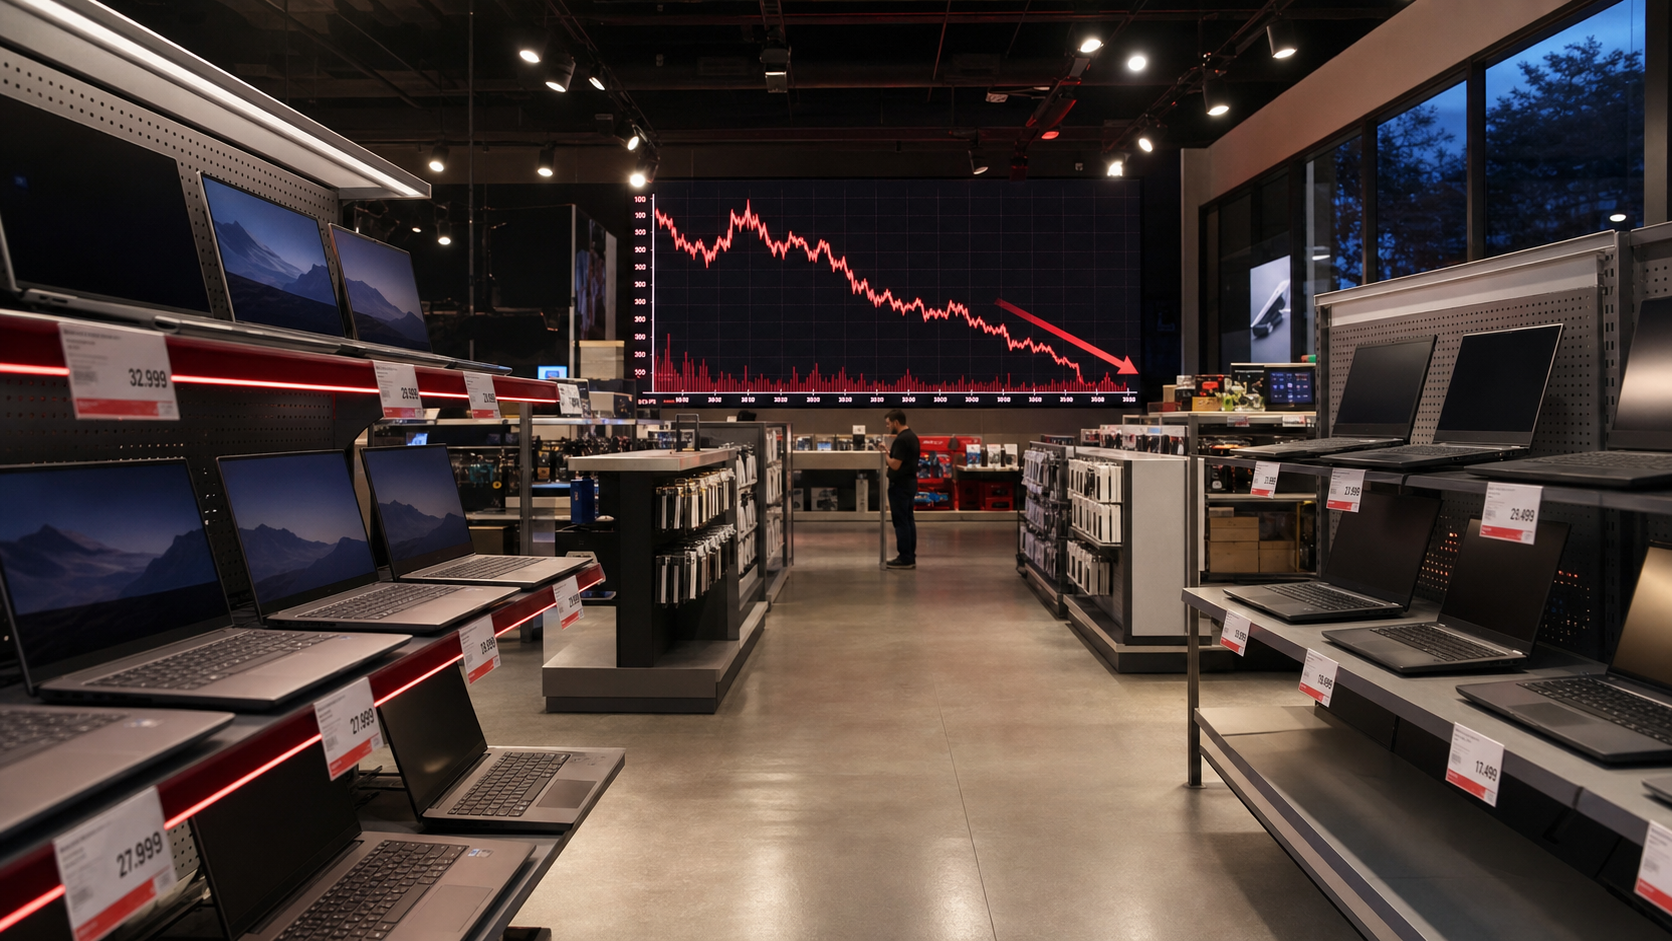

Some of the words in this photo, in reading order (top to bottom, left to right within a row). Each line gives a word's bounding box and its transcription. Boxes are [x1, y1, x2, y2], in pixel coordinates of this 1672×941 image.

[128, 368, 168, 388] 32.999
[350, 708, 375, 735] 27.999
[1475, 760, 1498, 782] 17.499
[116, 831, 163, 878] 27.999
